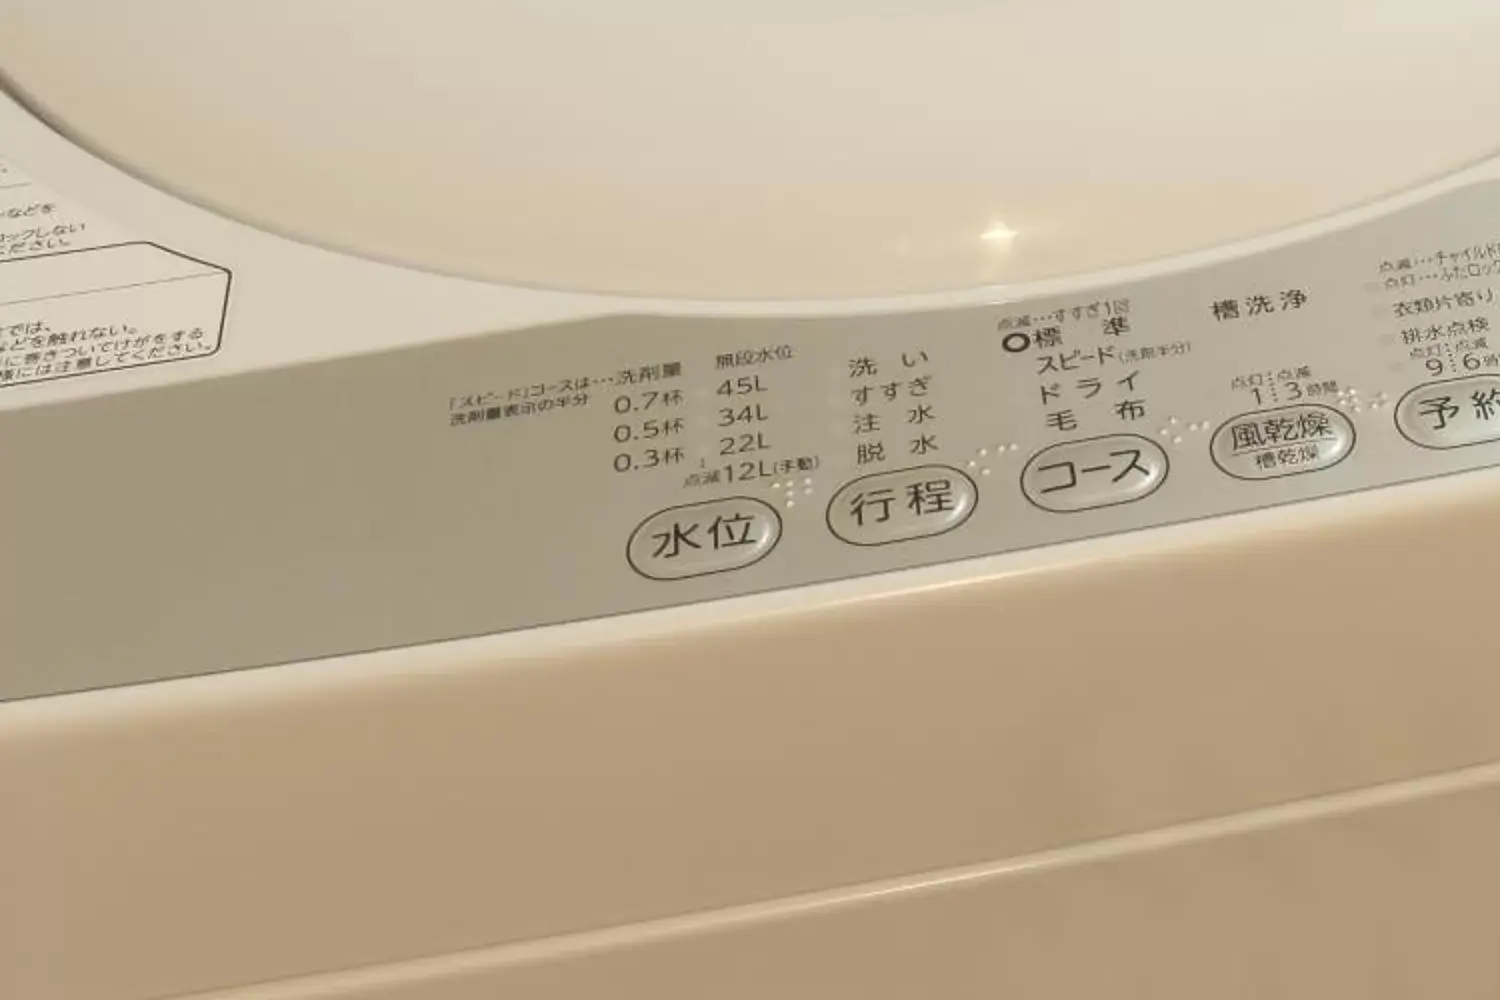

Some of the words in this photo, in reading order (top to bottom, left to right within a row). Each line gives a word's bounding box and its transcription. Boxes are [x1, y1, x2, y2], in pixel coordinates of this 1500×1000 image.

[1210, 289, 1308, 321] 槽洗浄
[1392, 287, 1495, 319] 衣類片寄り
[1033, 316, 1130, 349] 標準
[1400, 316, 1490, 344] 排水点検
[715, 345, 795, 370] 無段水位
[849, 350, 930, 378] 洗い
[1424, 357, 1444, 377] 9
[613, 388, 684, 414] 0.7杯
[716, 375, 769, 398] 45L
[851, 375, 934, 407] すすぎ
[1039, 370, 1141, 405] ドライ
[1251, 386, 1264, 406] 1
[718, 403, 769, 428] 34L
[854, 404, 936, 435] 注水
[1046, 398, 1146, 432] 毛布
[613, 417, 685, 443] 0.5杯
[719, 432, 771, 457] 22L
[1230, 411, 1334, 452] 風乾燥
[613, 447, 686, 473] 0.3杯
[856, 433, 940, 467] 脱水
[1256, 444, 1320, 470] 槽乾燥
[1037, 448, 1152, 495] コース
[849, 478, 955, 528] 行程
[651, 513, 758, 559] 水位
